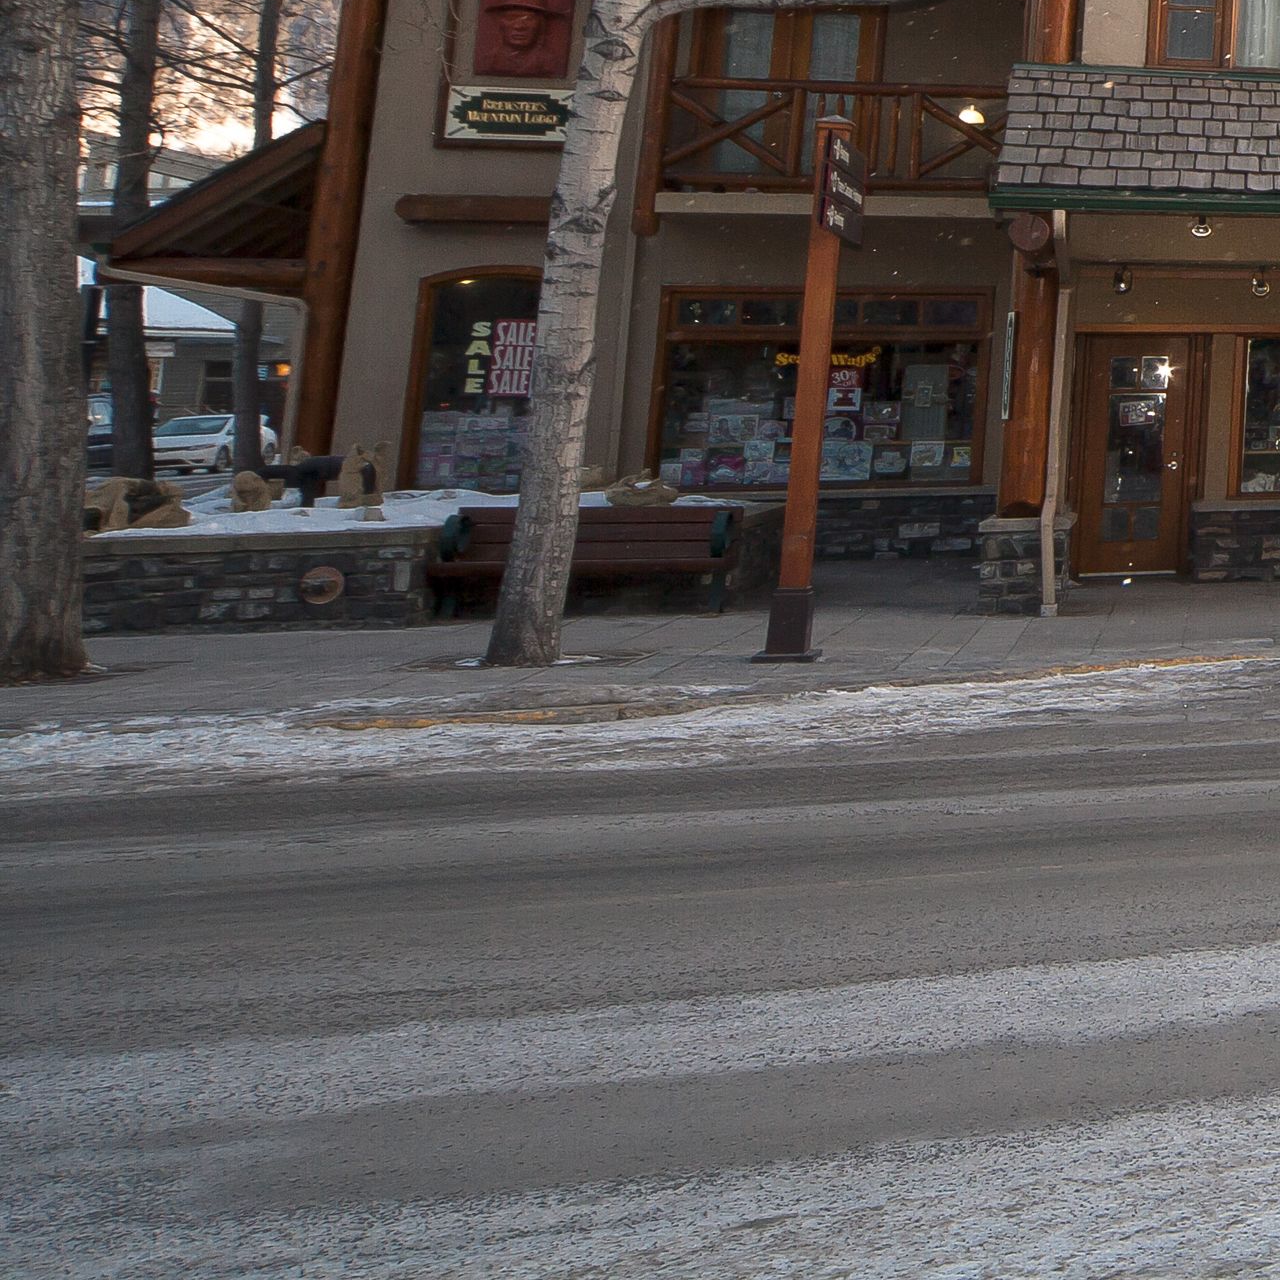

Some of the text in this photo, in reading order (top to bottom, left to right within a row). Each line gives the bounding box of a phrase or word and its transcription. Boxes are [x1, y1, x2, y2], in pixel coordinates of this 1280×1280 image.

[495, 322, 536, 345] SALE
[491, 346, 532, 370] SALE
[487, 370, 529, 394] SALE
